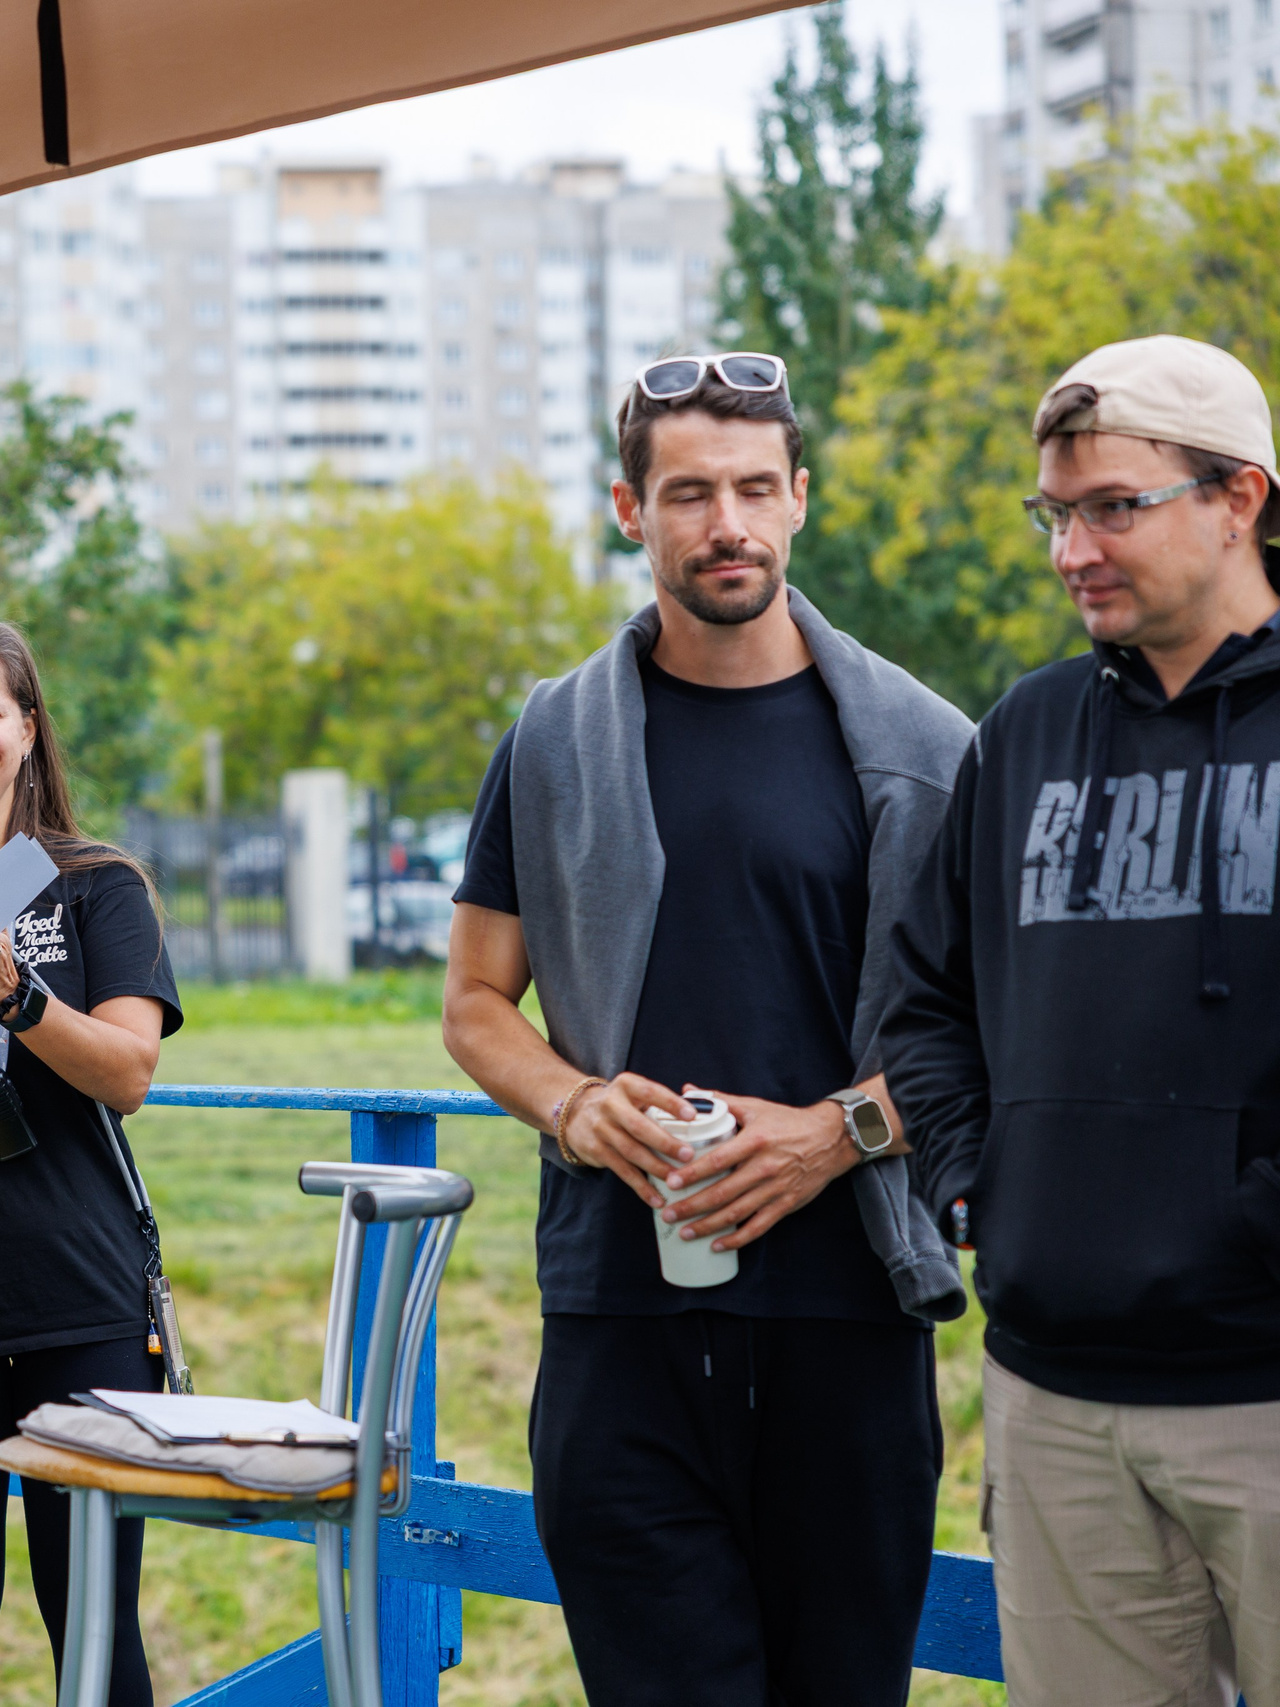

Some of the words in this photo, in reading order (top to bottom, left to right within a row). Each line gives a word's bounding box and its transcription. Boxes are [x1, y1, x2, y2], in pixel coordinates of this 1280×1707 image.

[15, 903, 63, 937] Iced
[15, 930, 65, 949] Matcha
[20, 946, 68, 967] Latte
